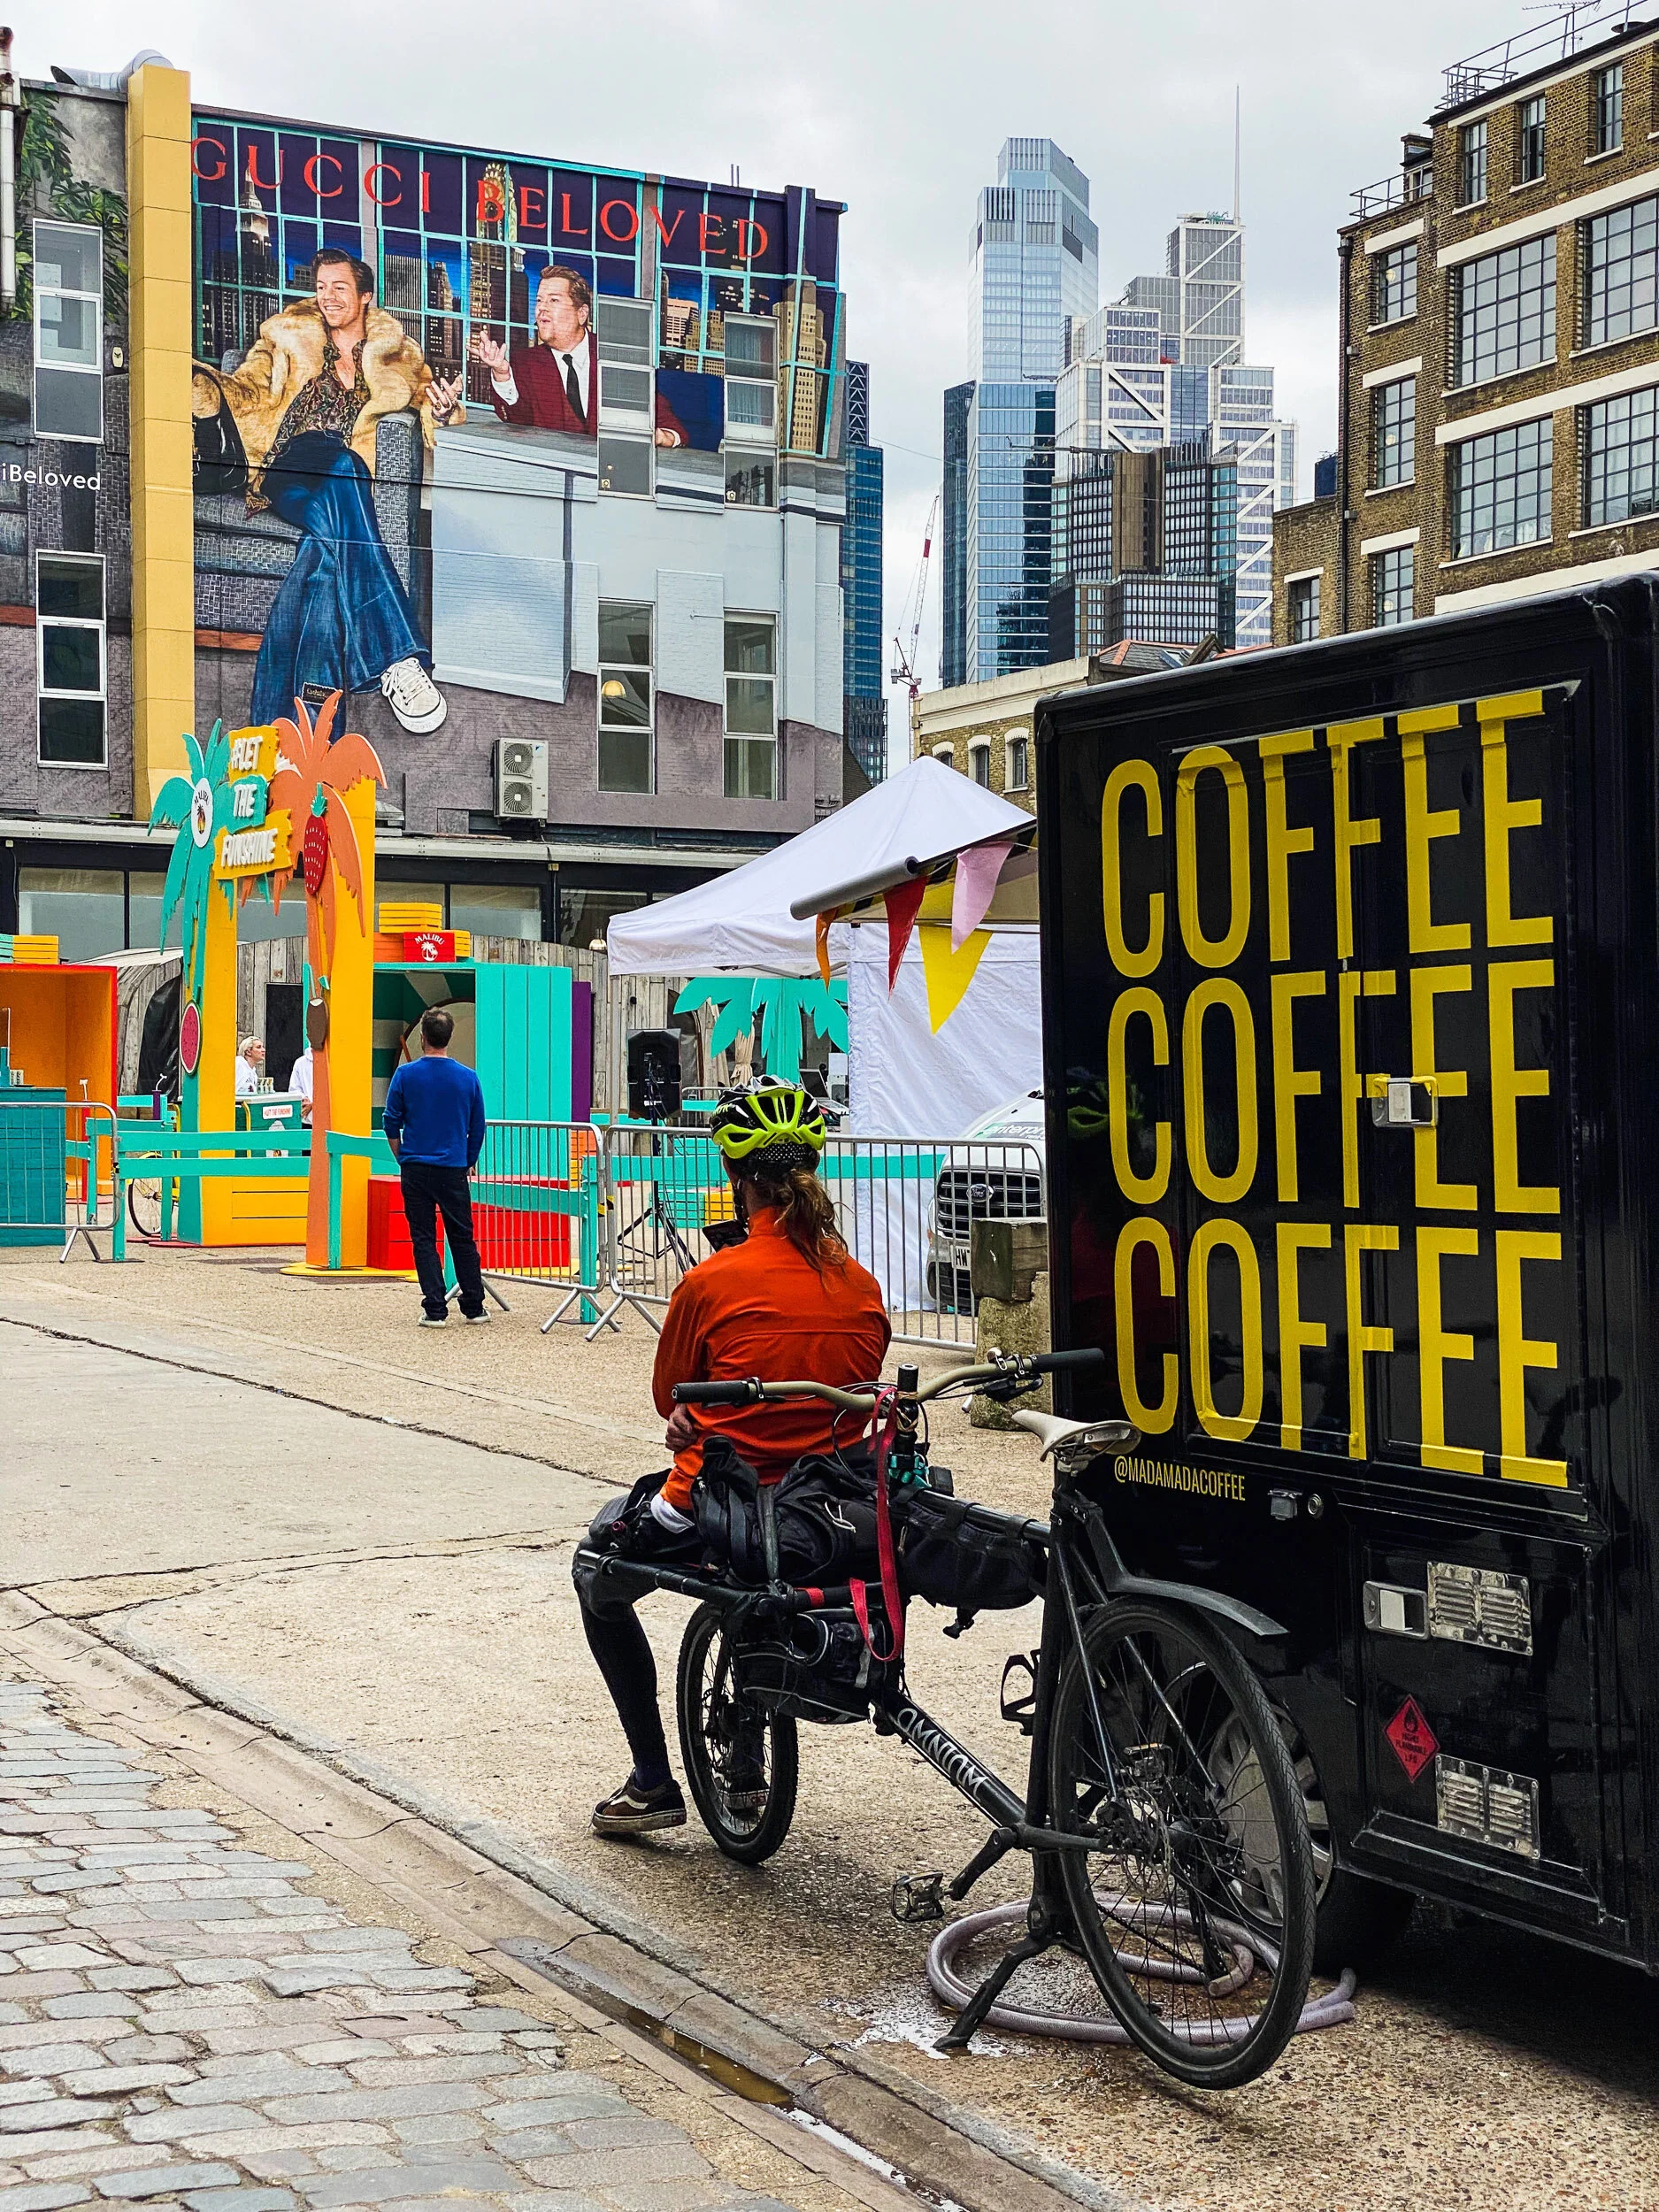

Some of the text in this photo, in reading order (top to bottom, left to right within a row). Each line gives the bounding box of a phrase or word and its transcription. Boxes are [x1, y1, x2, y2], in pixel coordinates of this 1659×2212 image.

[191, 137, 769, 259] GUCCI BELOVED
[2, 462, 101, 491] iBeloved
[234, 784, 257, 818] THE
[221, 828, 278, 867] FUNSHINE
[1102, 690, 1554, 978] COFFEE
[414, 933, 445, 946] MALIBU
[1108, 959, 1561, 1214] COFFEE
[1114, 1217, 1568, 1487] COFFEE
[1114, 1455, 1246, 1502] @MADAMADACOFFEE
